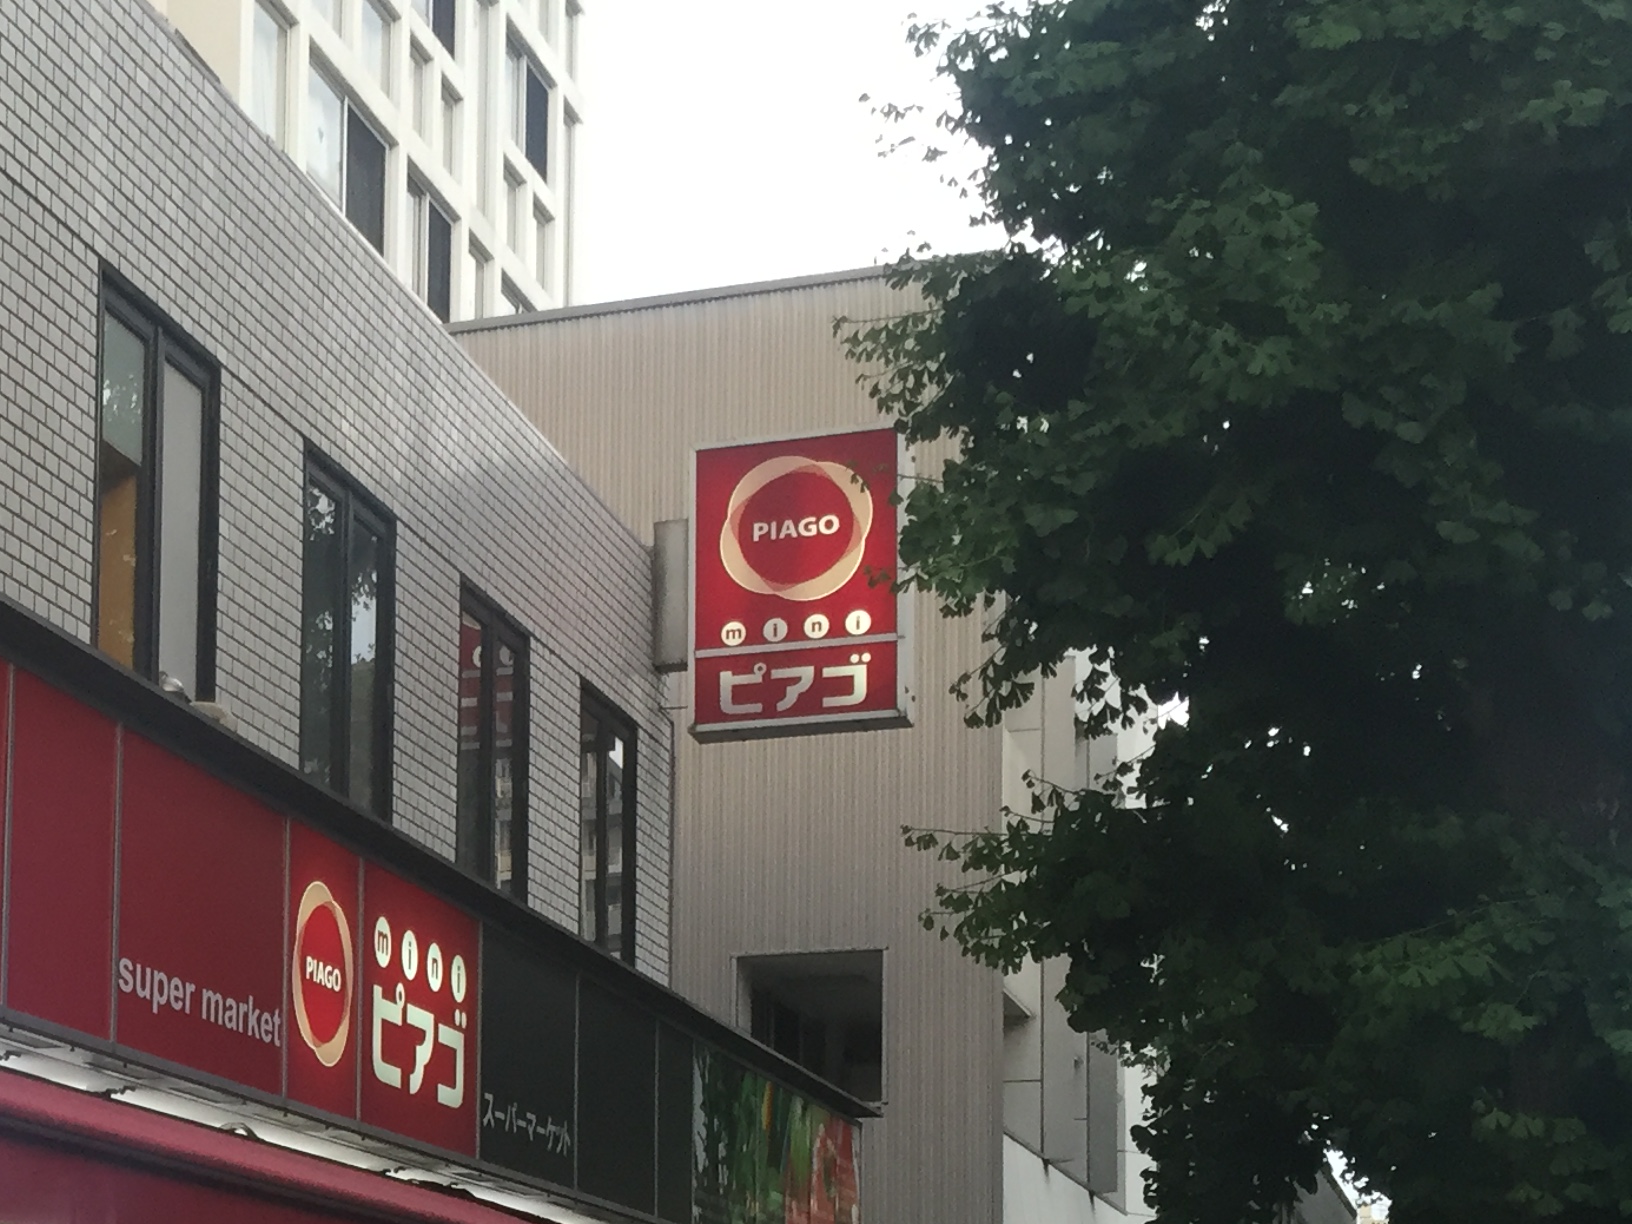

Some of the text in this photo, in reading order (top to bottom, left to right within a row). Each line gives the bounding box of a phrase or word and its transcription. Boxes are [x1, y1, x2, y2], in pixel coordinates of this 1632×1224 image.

[752, 514, 840, 542] PIAGO
[723, 612, 866, 643] mini
[719, 652, 872, 714] ピアゴ
[306, 955, 342, 993] PIAGO
[376, 922, 464, 998] mini
[118, 957, 282, 1048] super market
[372, 982, 467, 1109] ピアゴ
